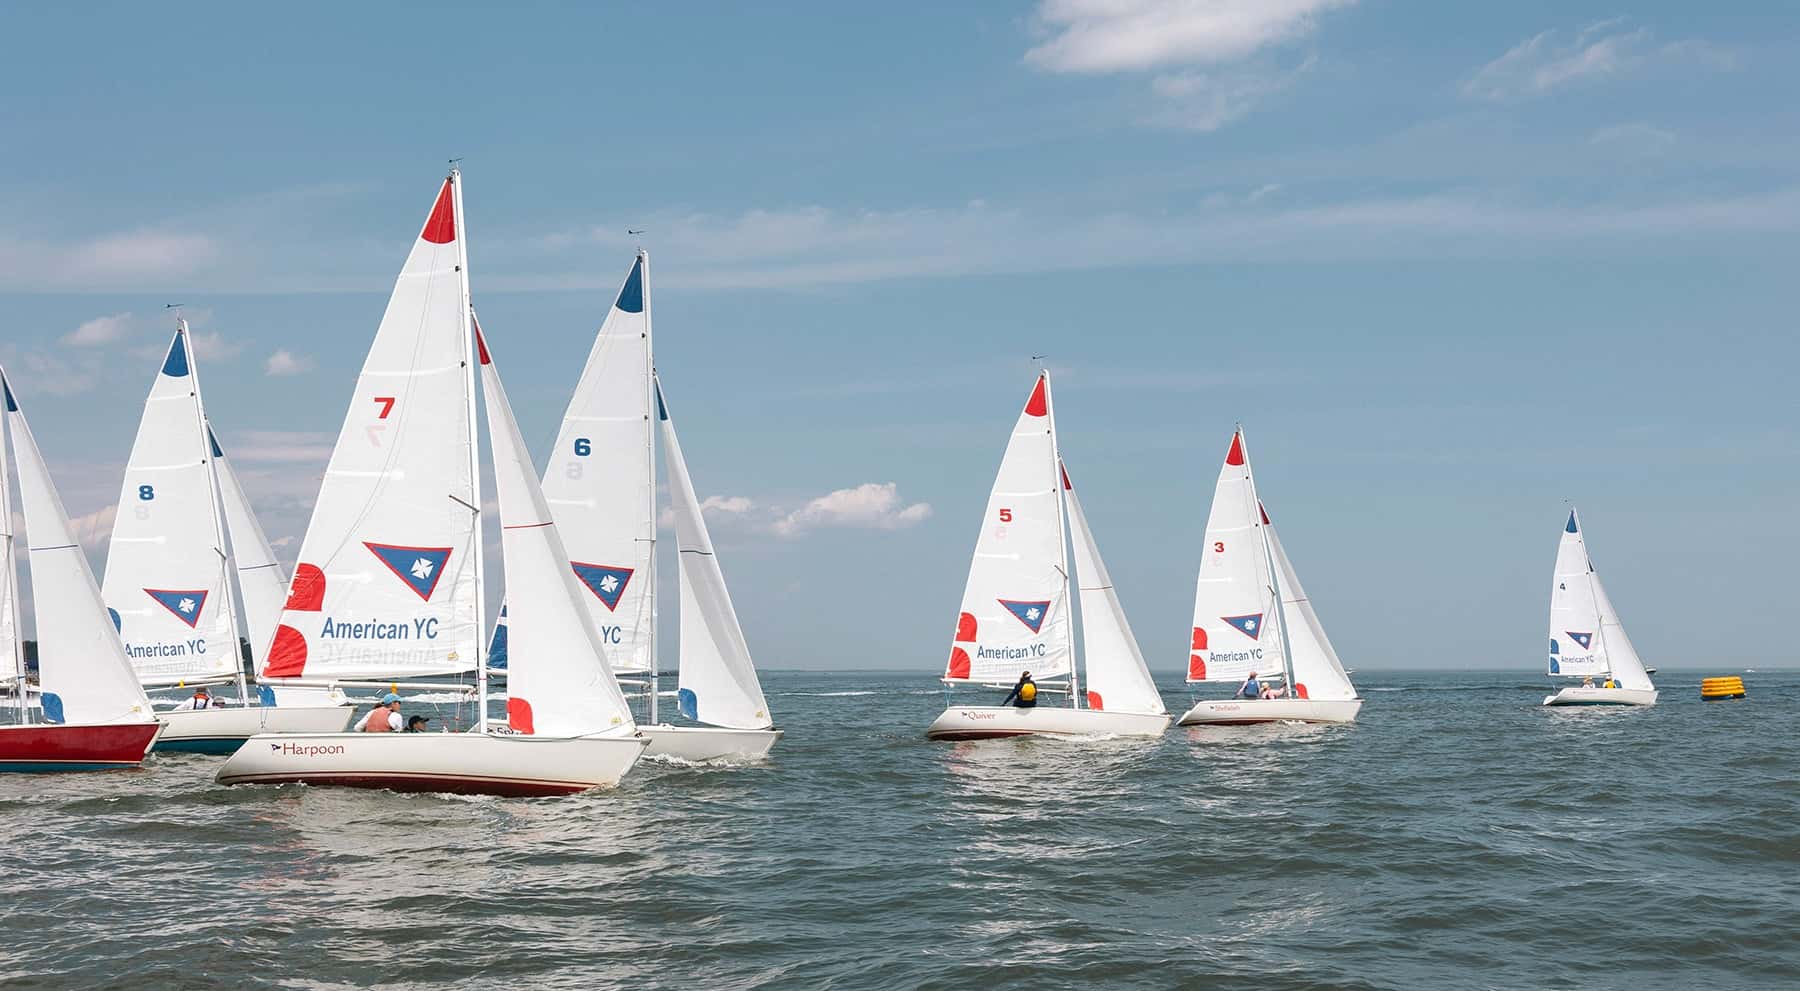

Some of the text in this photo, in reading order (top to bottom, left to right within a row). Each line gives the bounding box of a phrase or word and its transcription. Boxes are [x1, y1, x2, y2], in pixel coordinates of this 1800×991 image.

[374, 397, 395, 419] 7
[574, 438, 590, 457] 6
[139, 485, 154, 501] 8
[1000, 509, 1012, 522] 5
[1214, 542, 1225, 553] 3
[320, 616, 438, 640] American YC
[602, 625, 621, 644] YC
[124, 638, 207, 659] American YC
[977, 643, 1046, 659] American YC
[1210, 648, 1263, 662] American YC
[968, 711, 996, 721] Quiver
[283, 742, 345, 757] Harpoon
